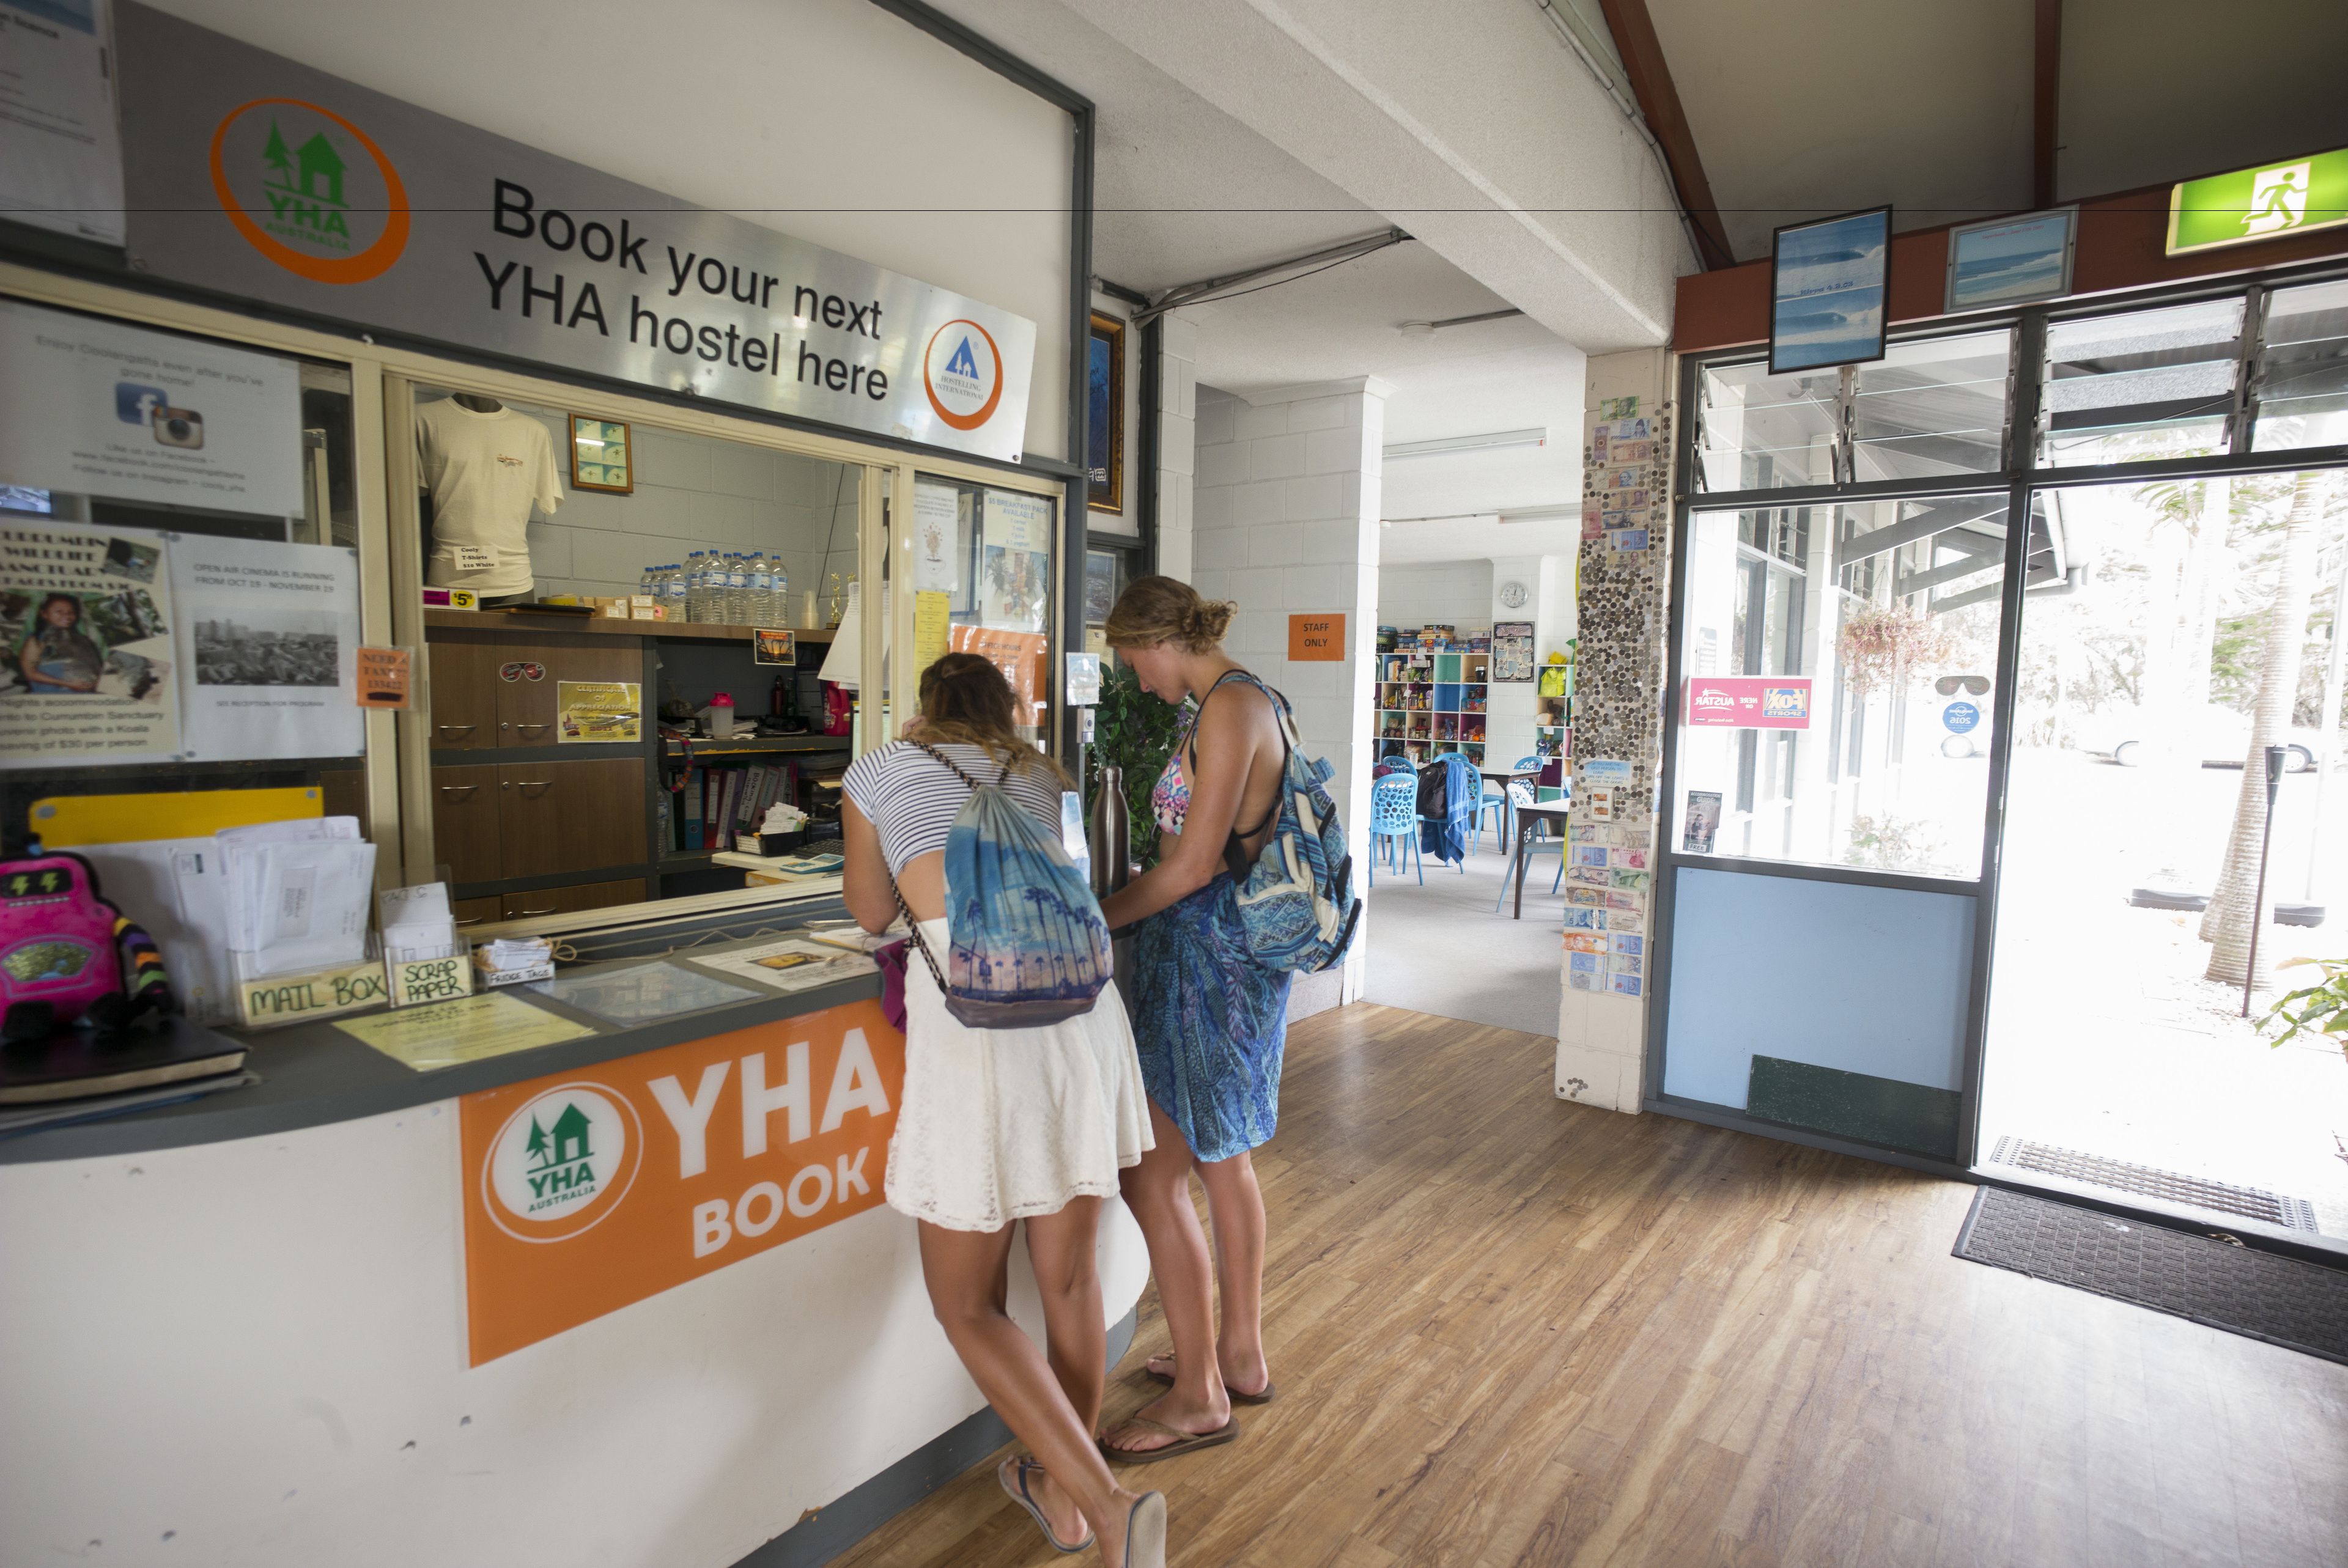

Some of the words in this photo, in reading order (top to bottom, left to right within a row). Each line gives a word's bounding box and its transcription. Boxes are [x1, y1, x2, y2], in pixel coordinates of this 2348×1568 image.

[263, 190, 350, 239] YHA
[264, 221, 351, 251] AUSTRALIA
[492, 177, 648, 274] Book
[667, 244, 778, 310] your
[794, 285, 882, 341] next
[473, 251, 610, 337] YHA
[630, 295, 780, 376] hostel
[798, 340, 888, 401] here
[936, 383, 984, 400] INTERNATIONAL
[941, 375, 981, 391] HOSTELLING
[988, 497, 996, 506] $5
[997, 499, 1032, 510] BREAKFAST
[1032, 504, 1048, 514] PACK
[1002, 509, 1035, 520] AVAILABLE
[193, 563, 221, 573] OPEN
[242, 567, 280, 576] CINEMA
[292, 572, 336, 581] RUNNING
[194, 576, 225, 585] FROM
[227, 578, 248, 587] OCT
[269, 581, 322, 592] NOVEMBER
[1303, 622, 1329, 633] STAFF
[1002, 643, 1022, 652] HOURS
[1304, 638, 1328, 648] ONLY
[404, 960, 457, 982] SCRAP
[251, 983, 327, 1017] MAIL
[329, 975, 387, 1006] BOX
[406, 976, 465, 1002] PAPER
[646, 1026, 892, 1180] YHA
[527, 1162, 596, 1199] YHA
[528, 1185, 597, 1213] AUSTRALIA
[692, 1146, 871, 1260] BOOK
